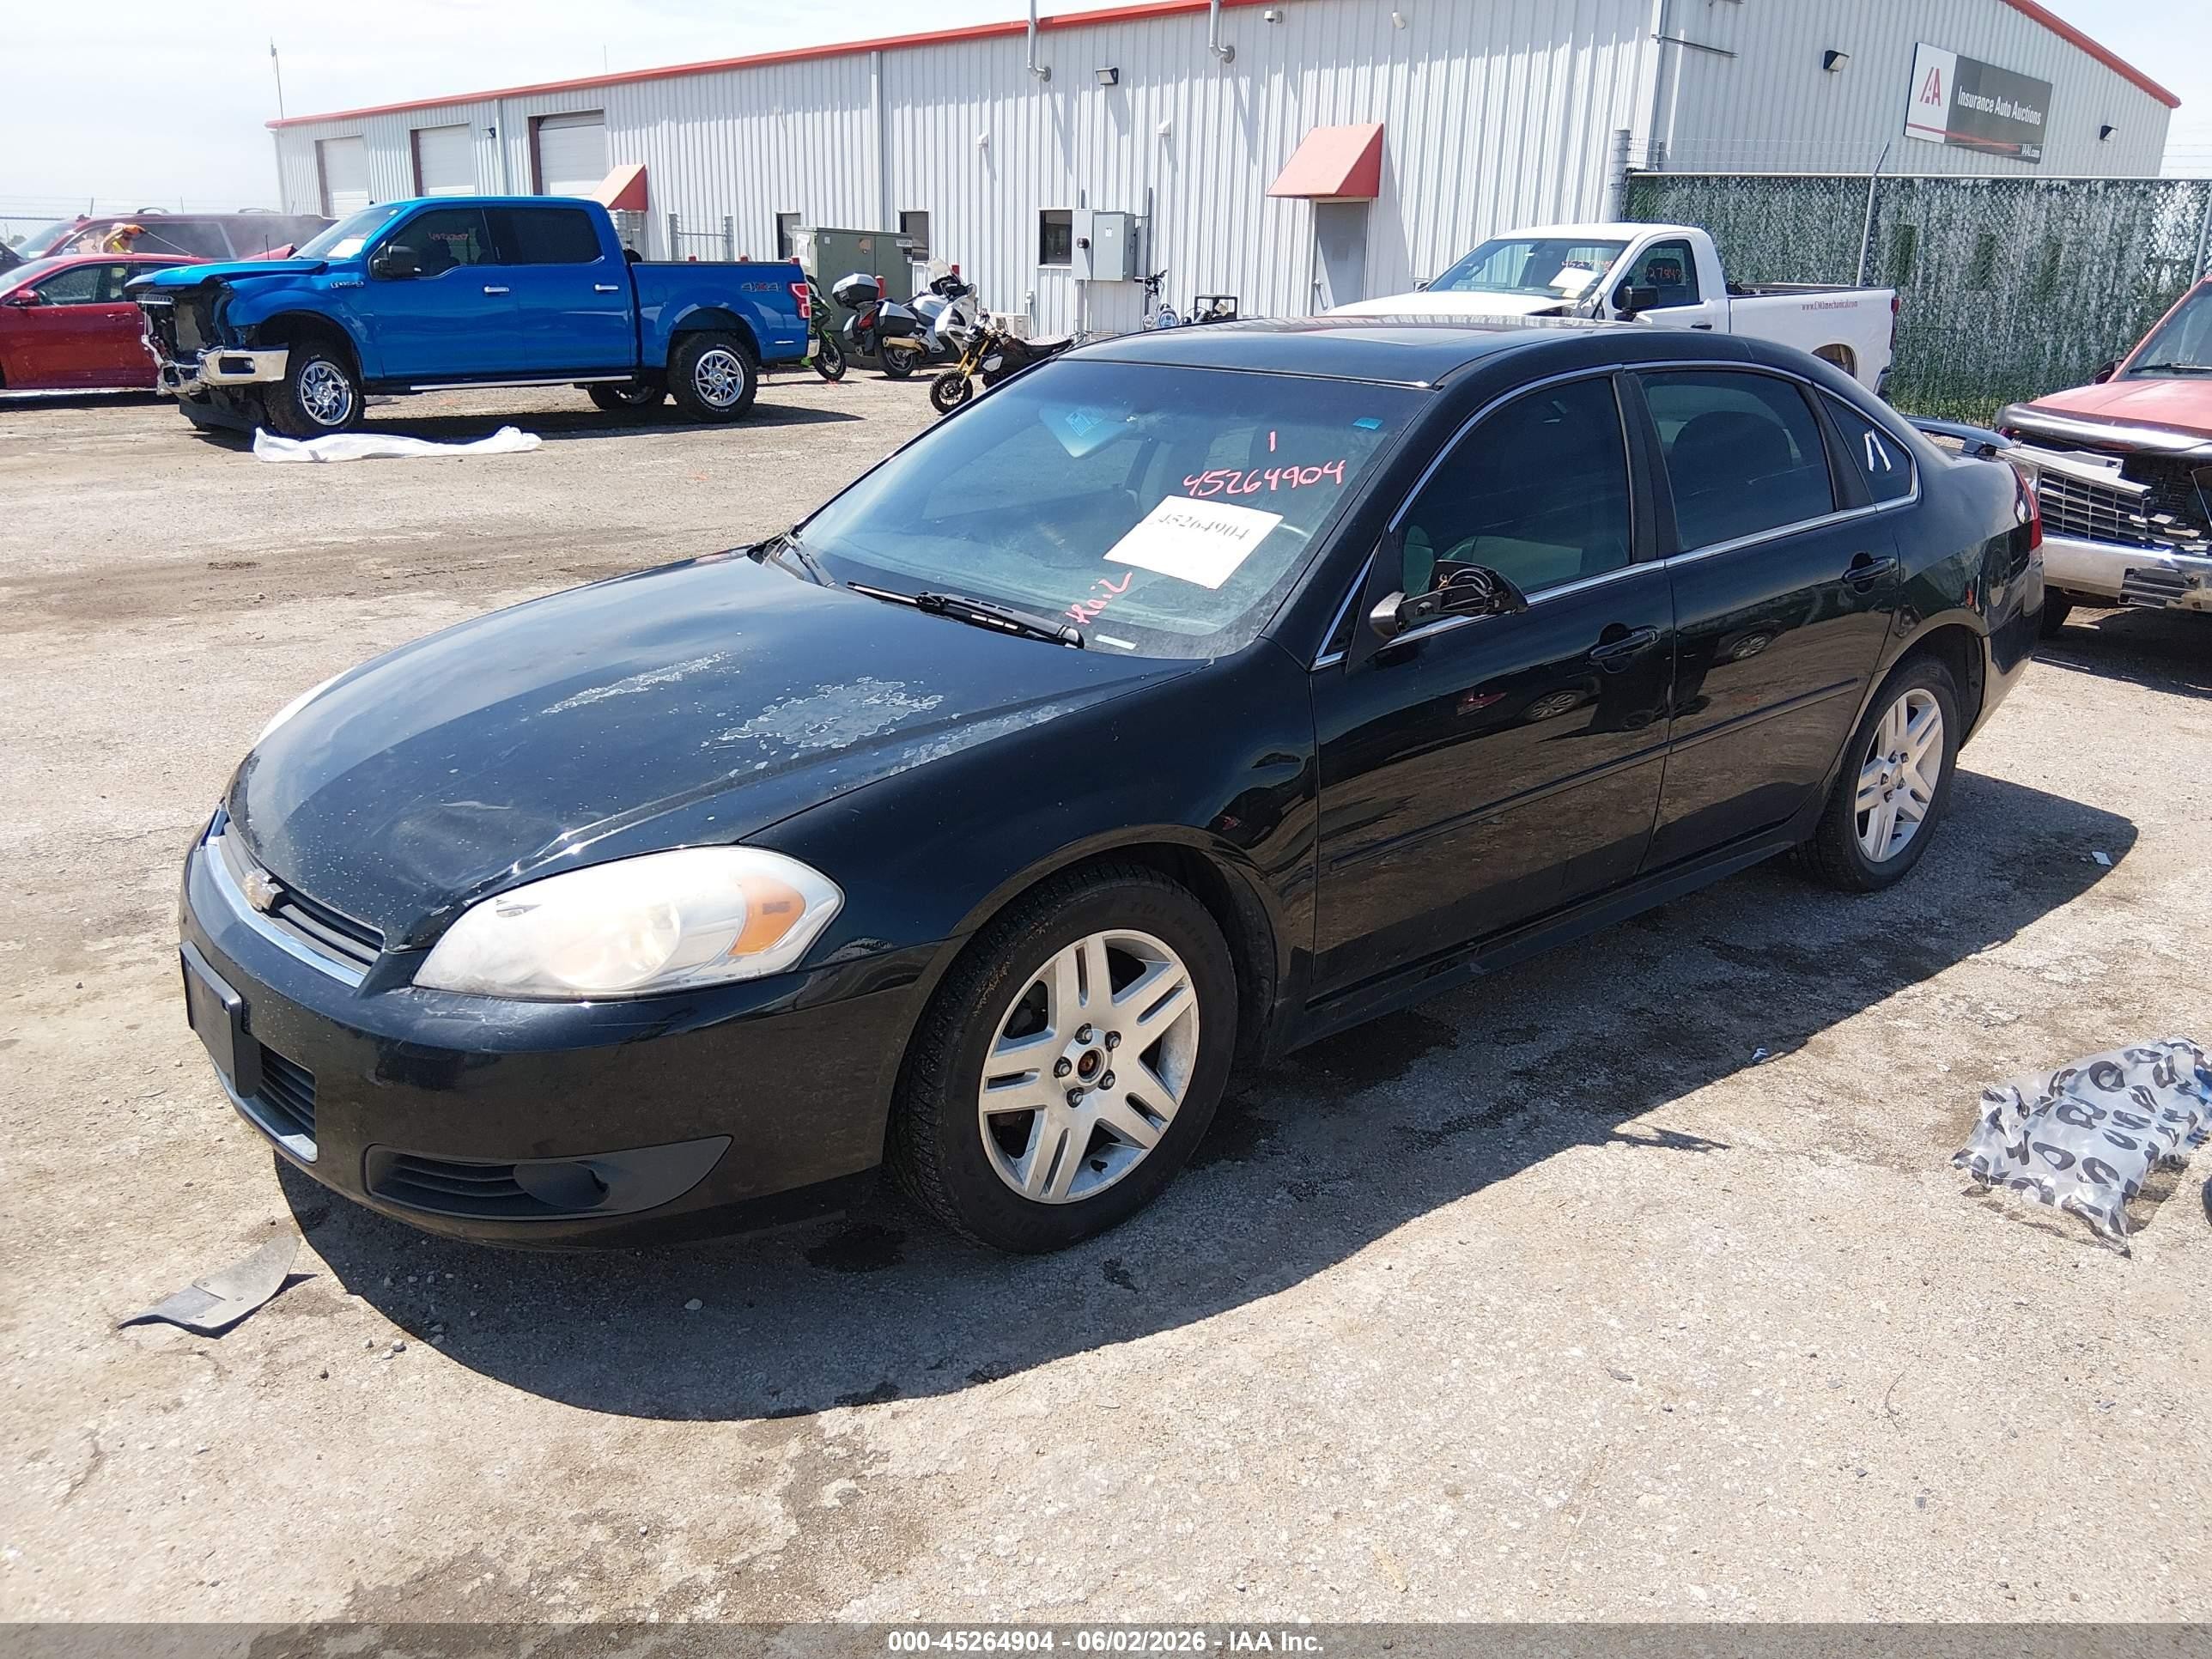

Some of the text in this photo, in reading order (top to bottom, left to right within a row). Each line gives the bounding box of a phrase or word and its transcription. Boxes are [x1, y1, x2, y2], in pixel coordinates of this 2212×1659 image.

[1957, 85, 2042, 125] Insurance Auto Auctions
[1182, 459, 1346, 497] 45264904
